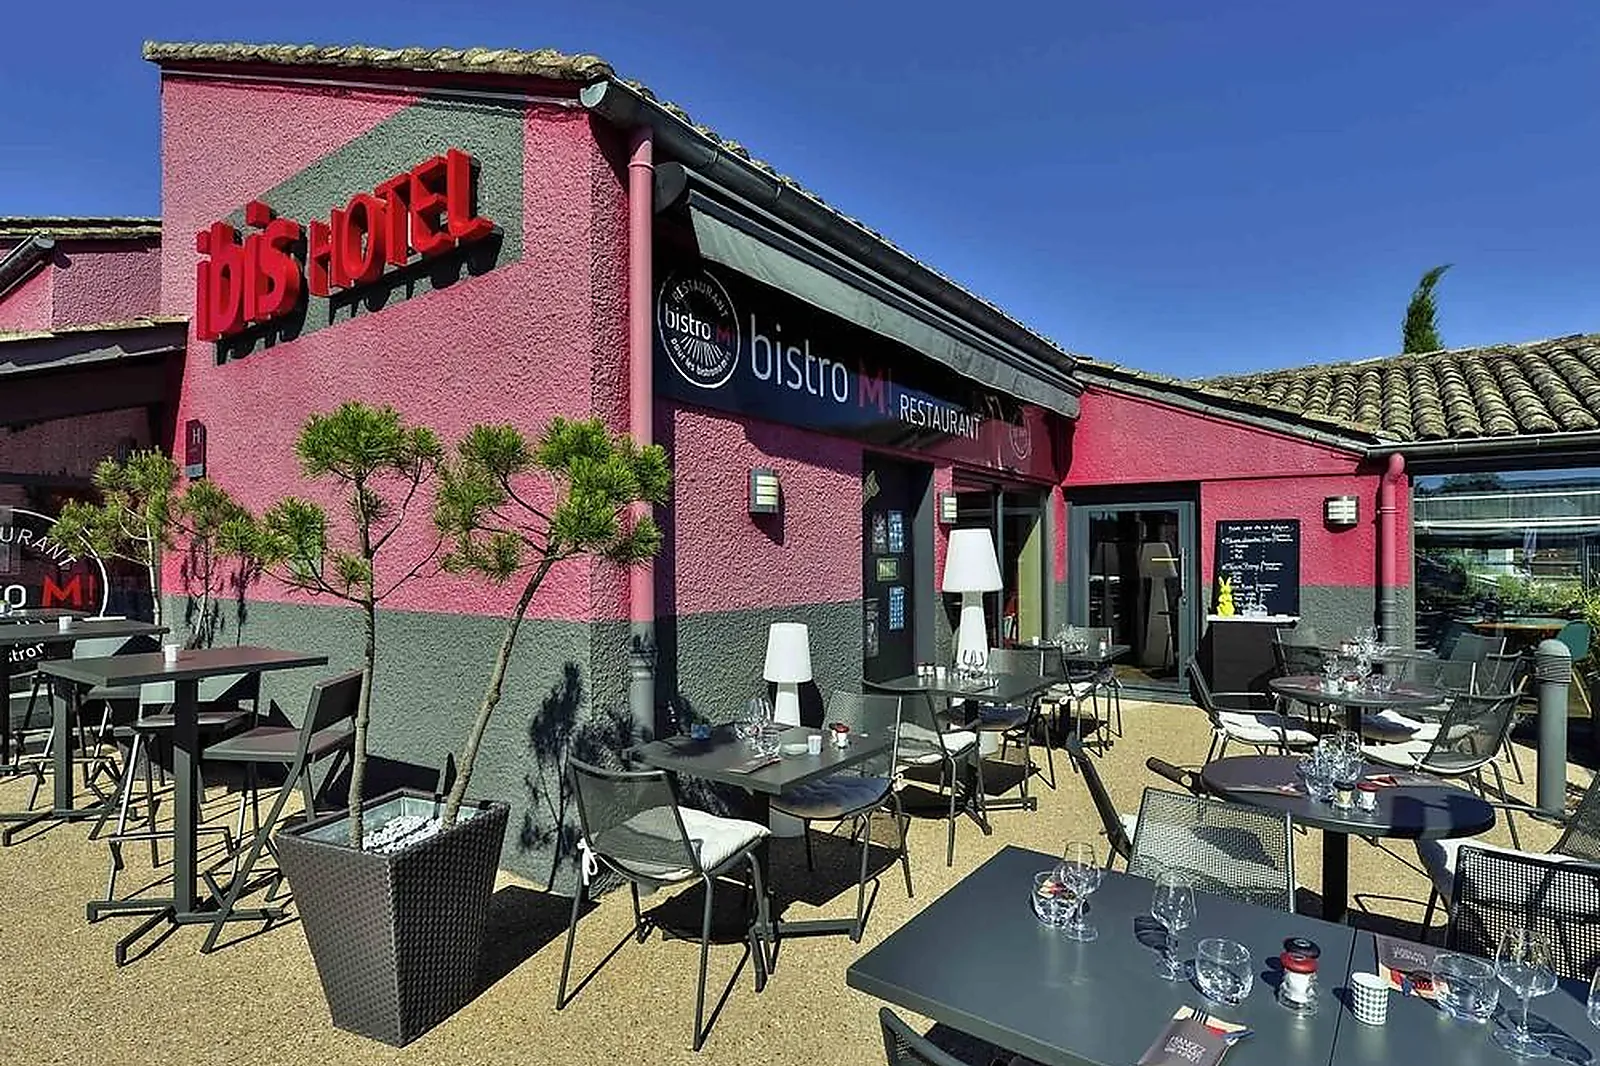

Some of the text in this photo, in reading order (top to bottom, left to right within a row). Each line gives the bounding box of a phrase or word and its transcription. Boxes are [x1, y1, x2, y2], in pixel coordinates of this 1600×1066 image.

[197, 147, 495, 342] ibis HOTEL
[665, 302, 711, 341] bistro
[751, 313, 848, 403] bistro
[899, 394, 983, 442] RESTAURANT
